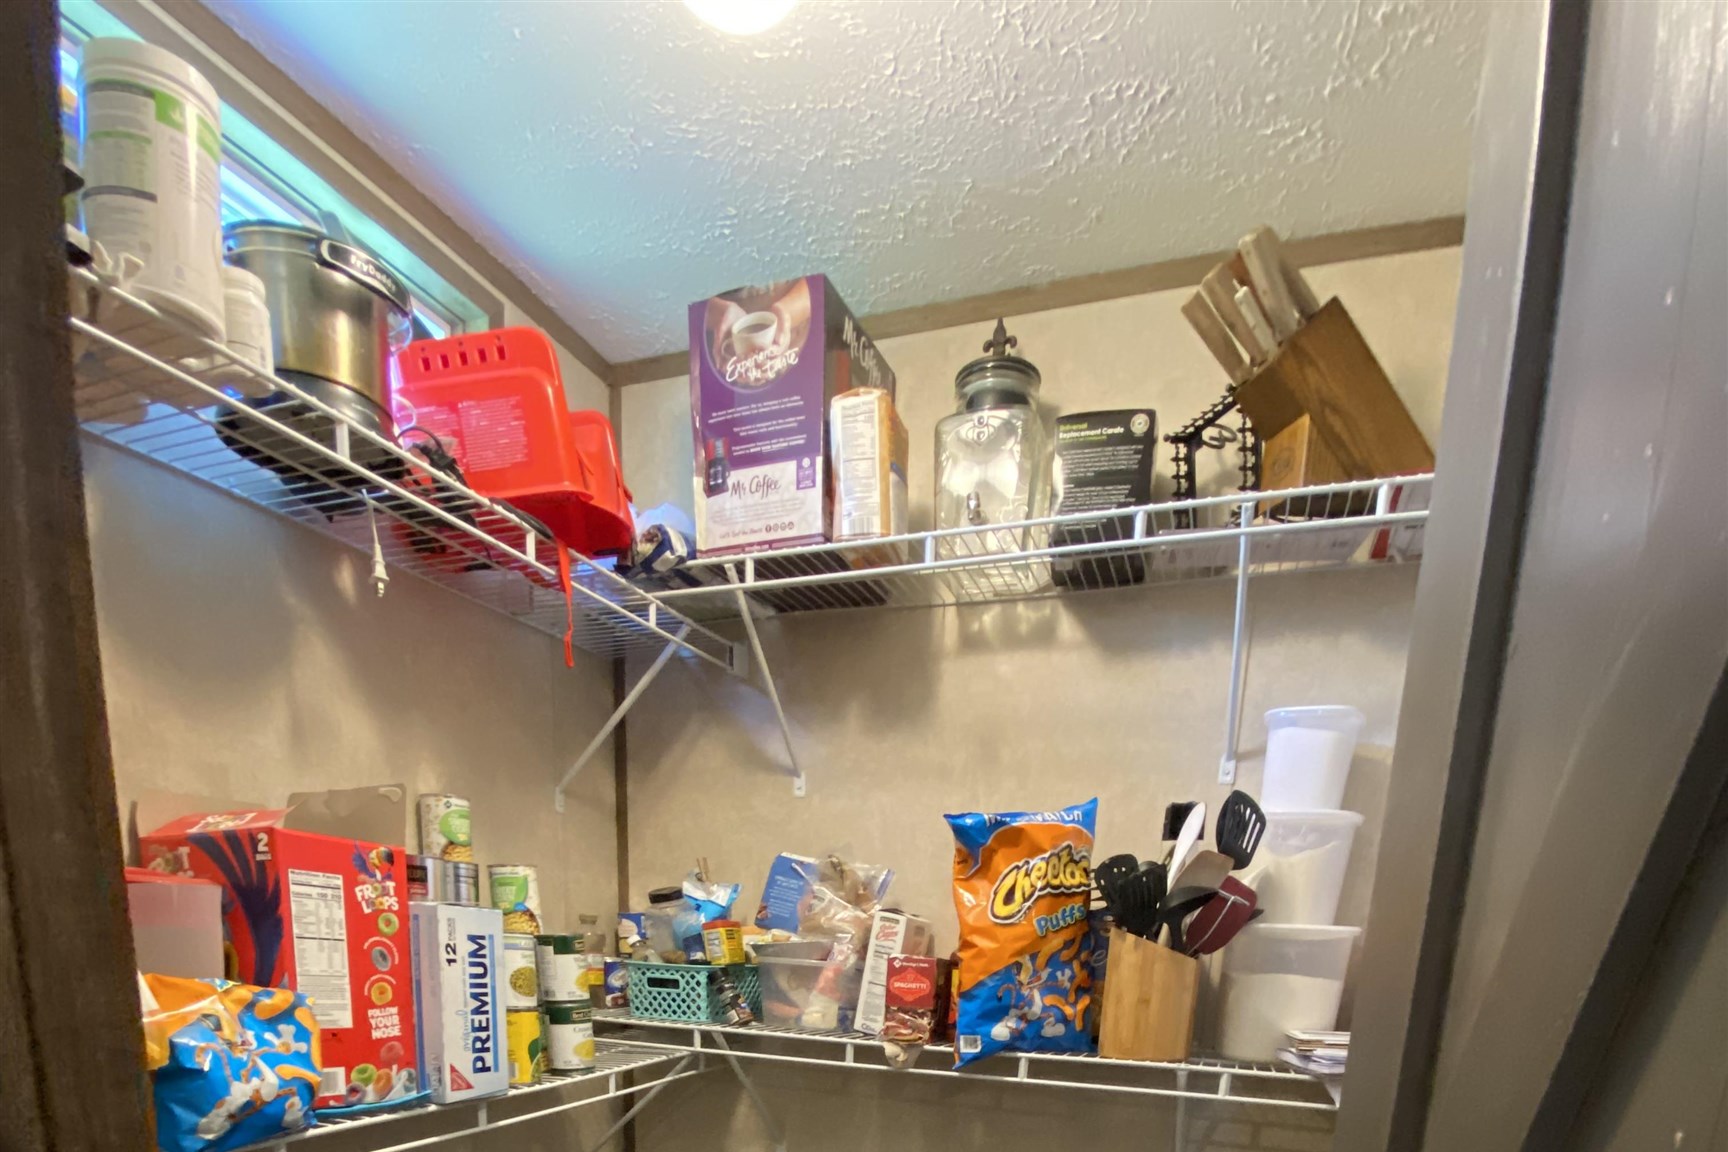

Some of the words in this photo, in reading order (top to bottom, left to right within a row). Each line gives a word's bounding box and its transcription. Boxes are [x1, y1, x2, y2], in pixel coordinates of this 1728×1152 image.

[762, 347, 799, 379] taste
[750, 474, 781, 500] Coffee
[257, 832, 269, 852] 2
[990, 843, 1091, 922] Cheetos
[1035, 903, 1088, 936] Puffs
[445, 943, 457, 967] 12
[894, 981, 927, 990] SPAGHETTI
[367, 1006, 398, 1017] FOLLOW
[467, 934, 491, 1074] PREMIUM
[369, 1015, 400, 1029] YOUR
[371, 1025, 402, 1039] NOSE
